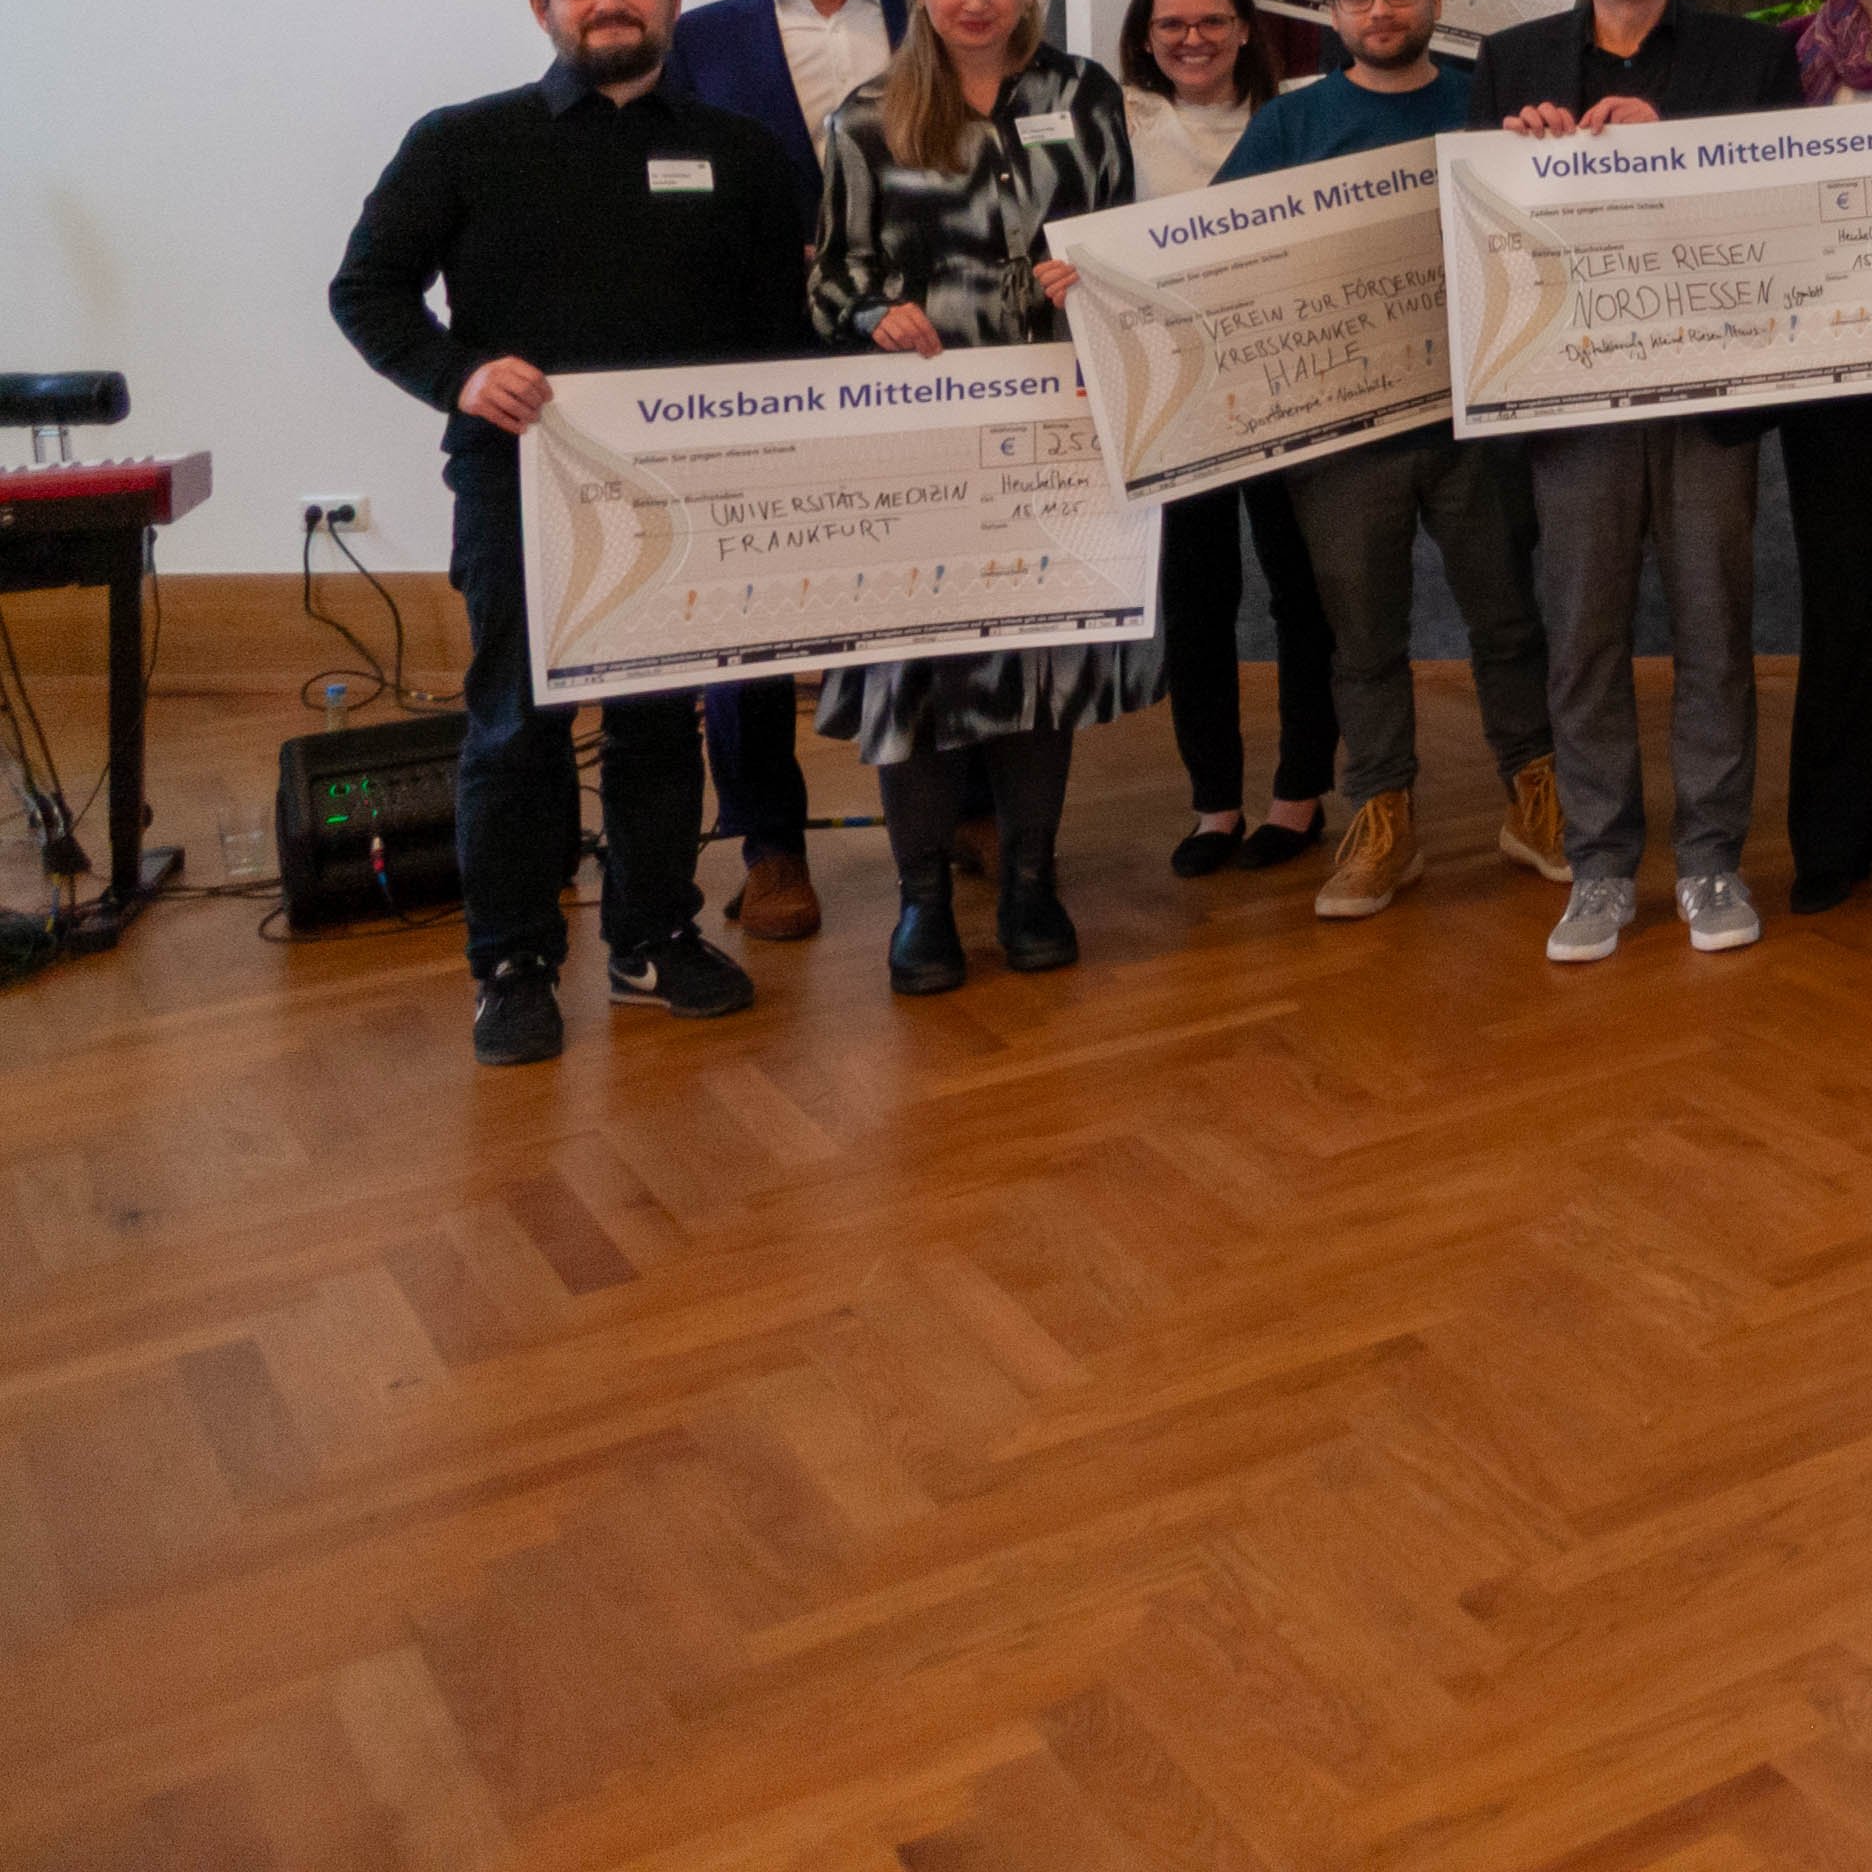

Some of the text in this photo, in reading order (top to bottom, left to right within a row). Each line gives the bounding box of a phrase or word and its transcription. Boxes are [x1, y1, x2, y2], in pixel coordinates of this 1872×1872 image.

[1531, 146, 1686, 179] Volksbank
[1148, 194, 1306, 251] Volksbank
[1835, 191, 1850, 210] €
[1569, 240, 1768, 281] KLEINE RIESEN
[1206, 305, 1285, 342] VEREIN
[1295, 294, 1338, 320] ZUR
[1571, 275, 1775, 330] NORDHESSEN
[1213, 312, 1377, 376] KREBSKRANKER
[636, 371, 1062, 424] Volksbank Mittelhessen
[1000, 436, 1016, 457] €
[717, 516, 901, 562] FRANKFURT
